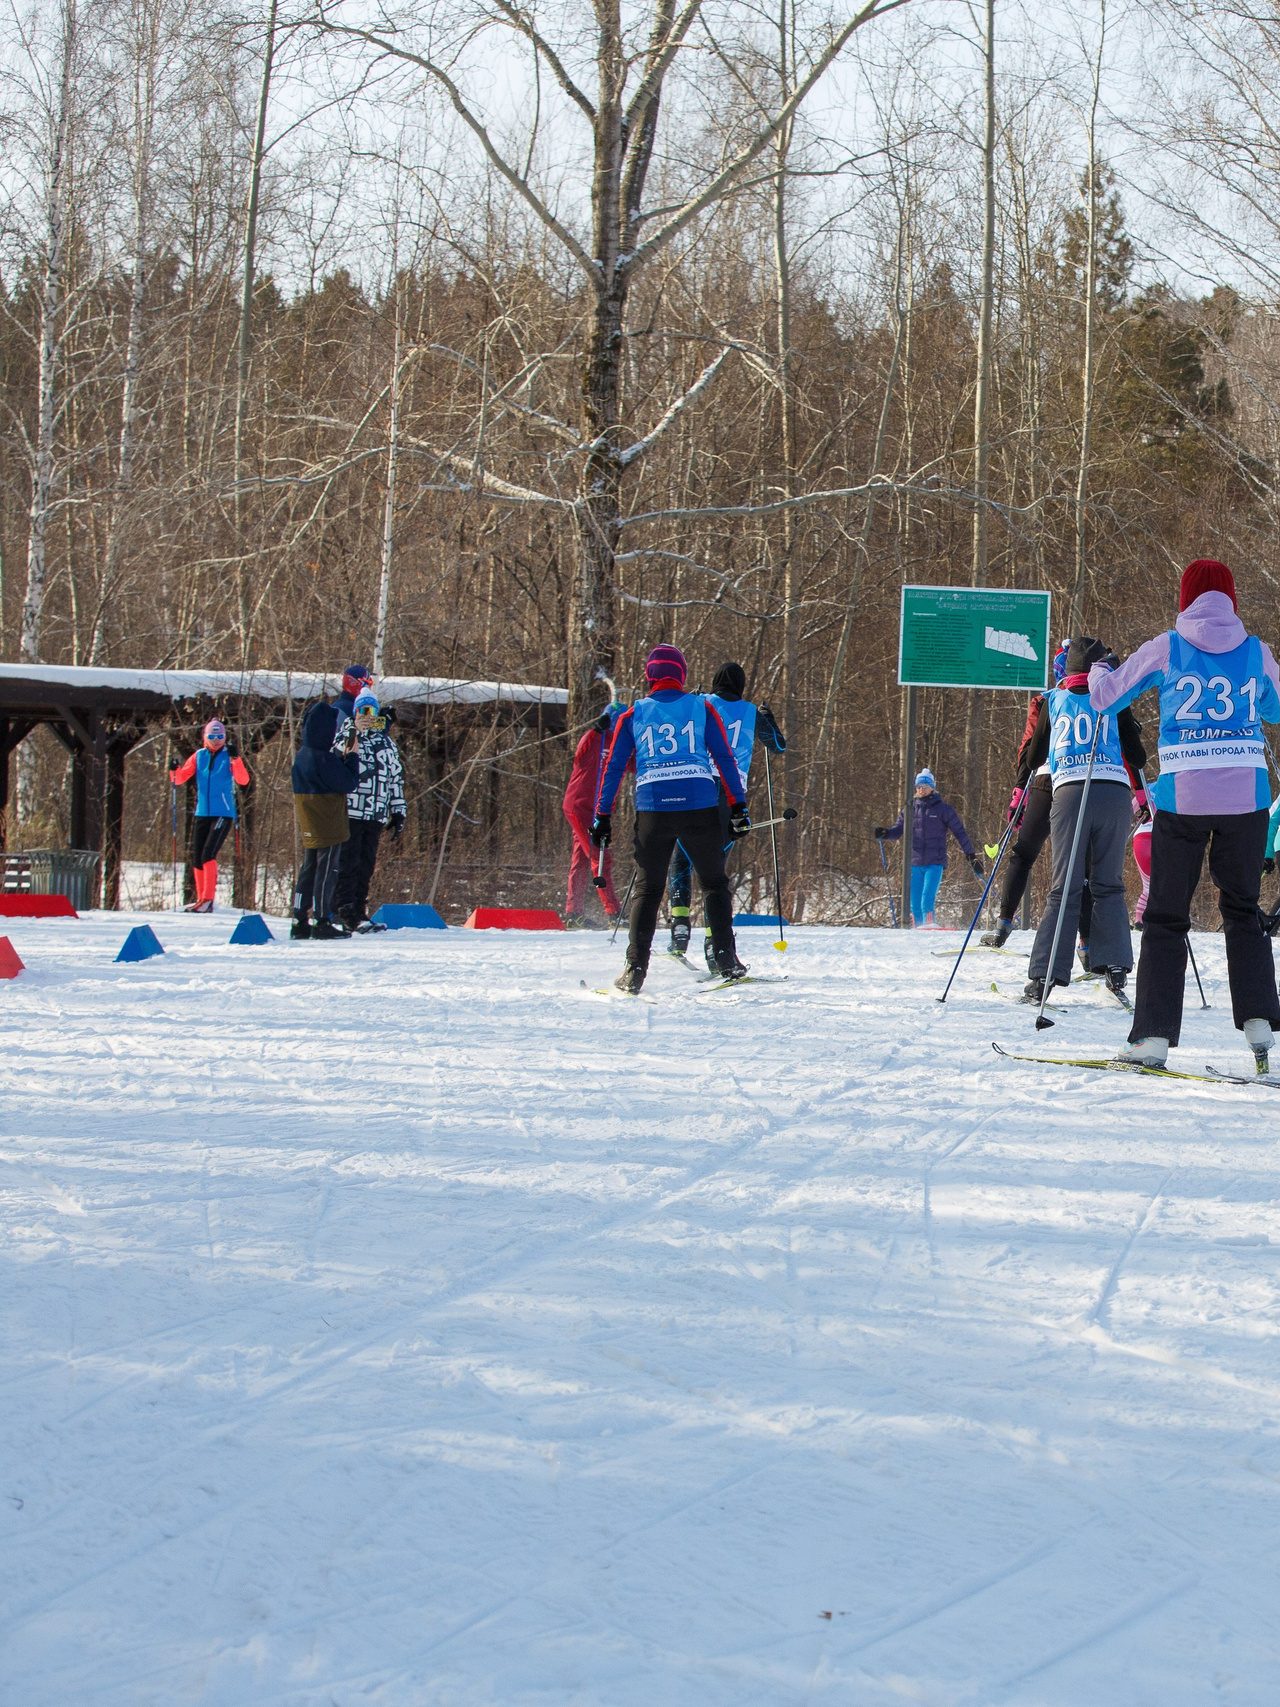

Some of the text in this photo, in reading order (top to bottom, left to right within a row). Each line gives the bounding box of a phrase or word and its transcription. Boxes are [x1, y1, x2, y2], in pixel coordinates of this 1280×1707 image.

[1175, 675, 1257, 722] 231
[641, 720, 696, 757] 131
[1054, 712, 1110, 750] 201
[1181, 749, 1208, 758] ГЛАВЫ
[1211, 746, 1245, 756] ГОРОДА
[672, 769, 698, 777] ГОРОДА
[1106, 1061, 1144, 1073] FISCHER
